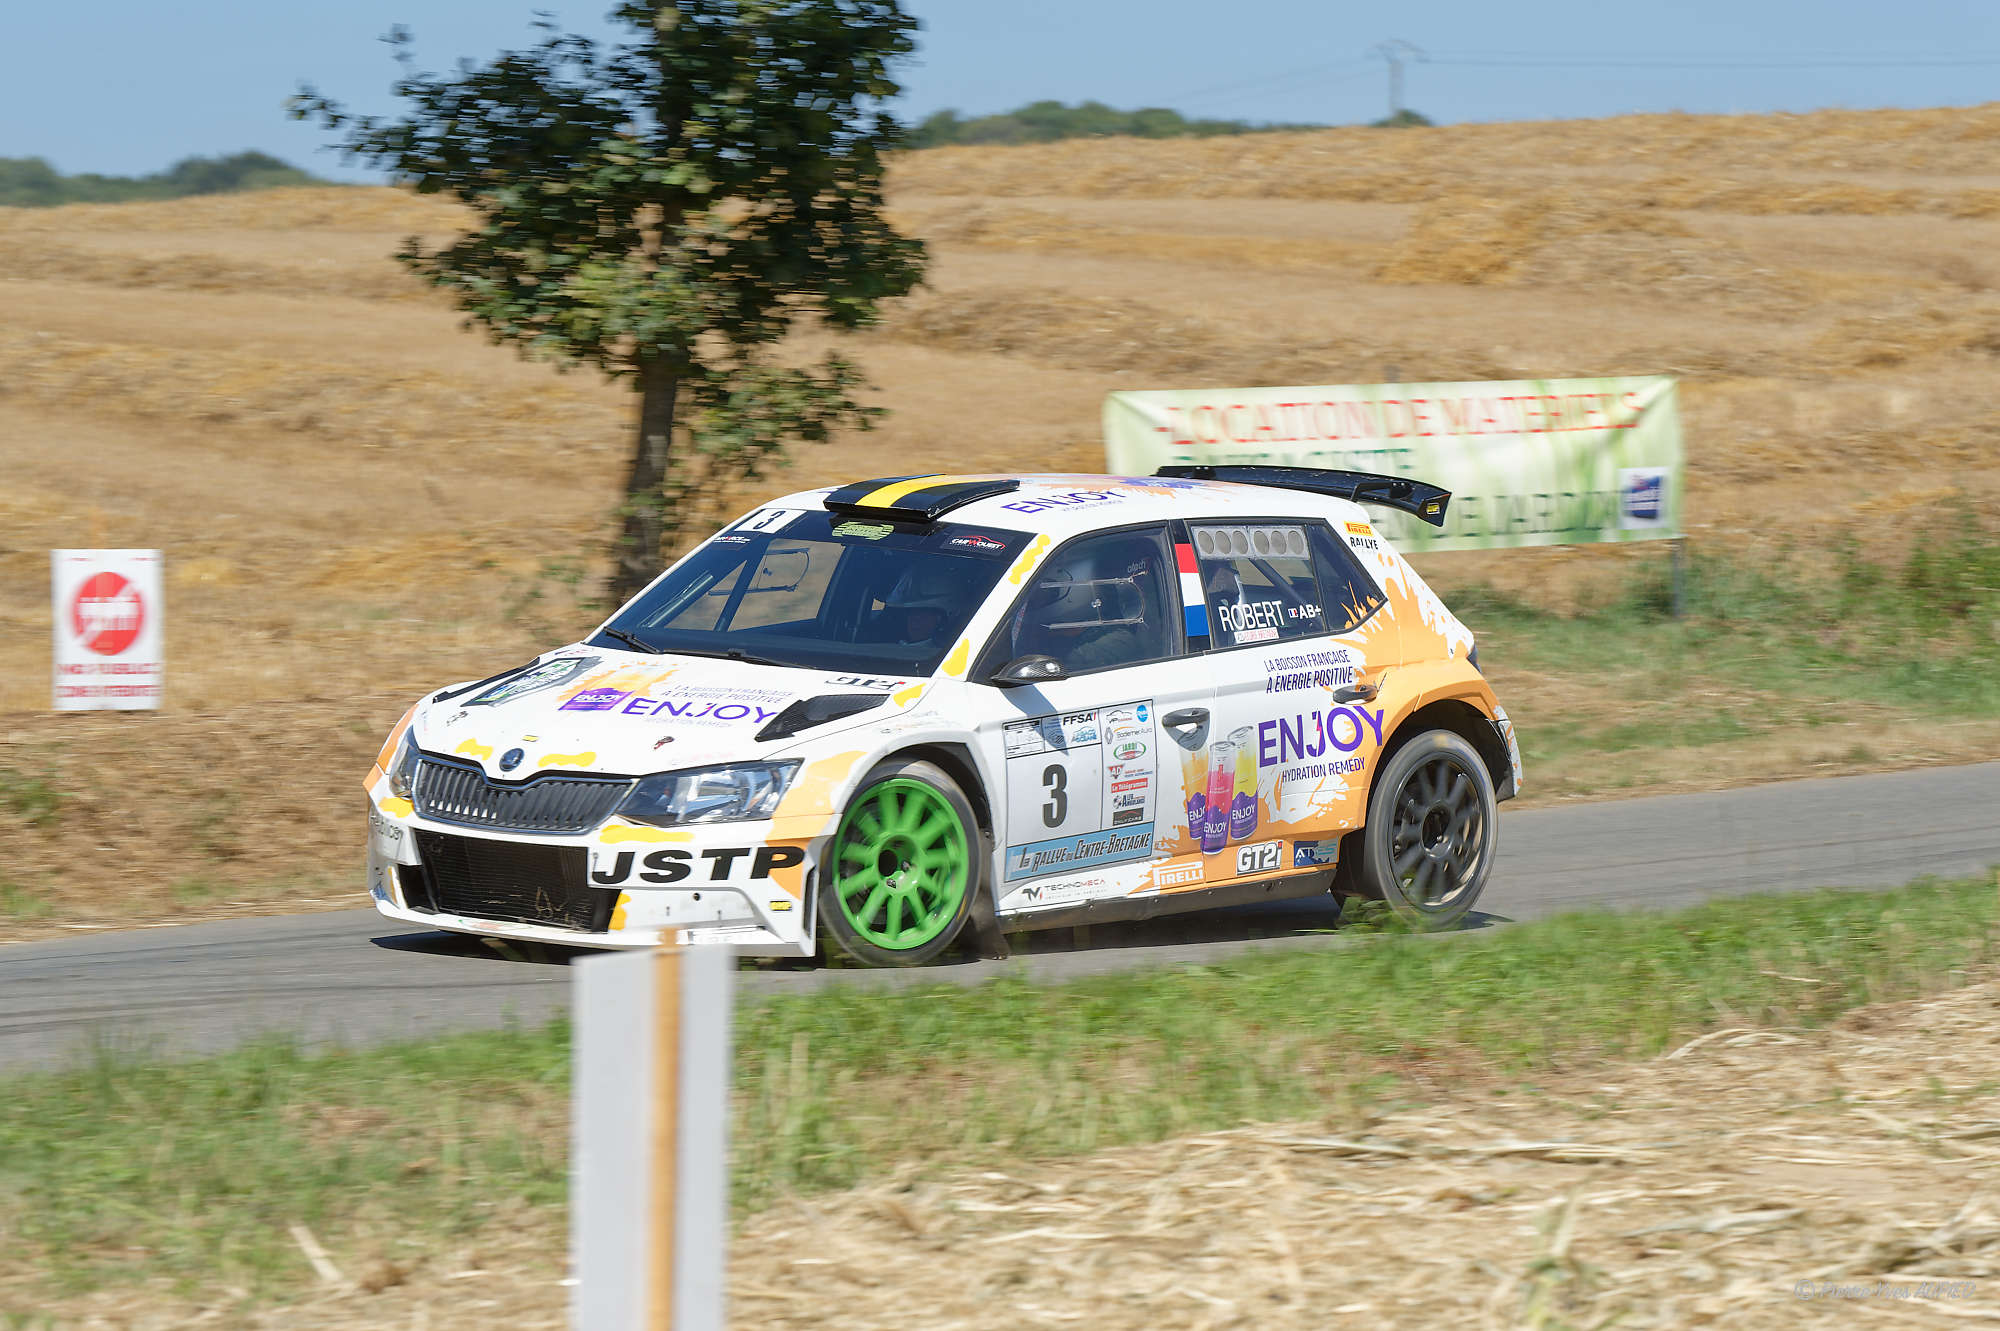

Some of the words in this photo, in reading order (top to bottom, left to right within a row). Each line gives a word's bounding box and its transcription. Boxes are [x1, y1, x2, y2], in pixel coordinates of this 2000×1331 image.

[1000, 491, 1126, 513] ENJOY
[753, 510, 786, 530] 3
[1346, 522, 1373, 536] PIRELLI
[1350, 537, 1379, 550] RALLYE
[1218, 600, 1285, 632] ROBERT
[1264, 659, 1275, 672] LA
[1275, 655, 1308, 671] BOISSON
[1313, 665, 1354, 688] POSITIVE
[621, 697, 778, 724] ENJOY
[1062, 712, 1094, 726] FFSA
[1258, 706, 1385, 768] ENJOY
[1282, 763, 1327, 783] HYDRATION
[1328, 757, 1365, 776] REMEDY
[1042, 764, 1068, 828] 3
[1233, 804, 1256, 820] ENJOY
[1204, 821, 1227, 834] ENJOY
[1032, 848, 1068, 872] RALLYE
[1074, 833, 1152, 860] CENTRE-BRETAGNE
[1237, 840, 1283, 873] GT2i
[592, 846, 805, 884] JSTP
[1153, 861, 1204, 886] PIRELLI
[1045, 879, 1106, 891] TECHNOMECA
